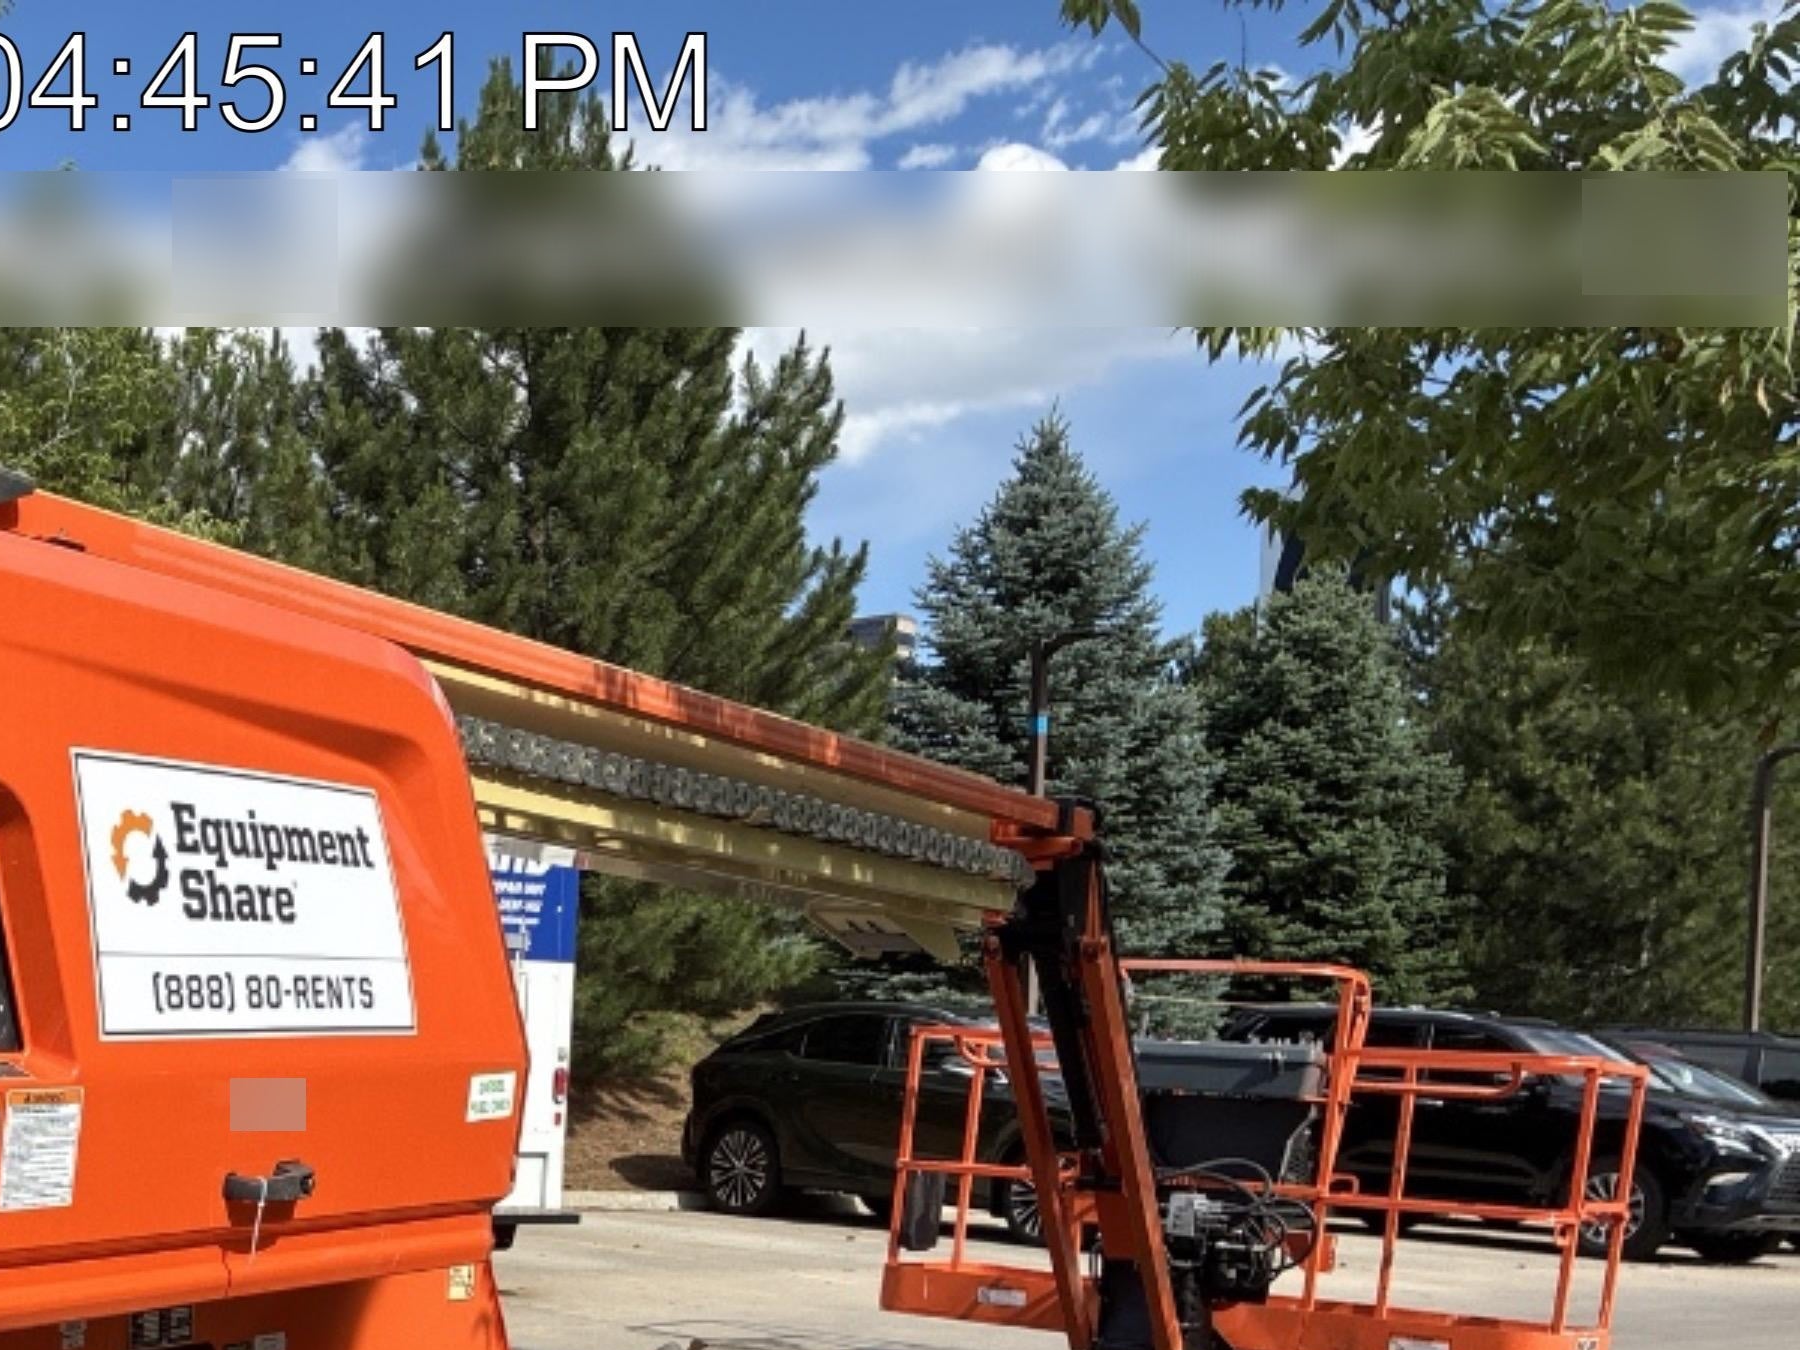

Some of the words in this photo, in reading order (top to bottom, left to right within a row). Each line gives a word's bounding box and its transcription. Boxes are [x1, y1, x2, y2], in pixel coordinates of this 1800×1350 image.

[170, 800, 375, 871] Equipment
[179, 868, 297, 924] Share
[152, 971, 236, 1015] (888)
[245, 974, 375, 1010] 80-RENTS
